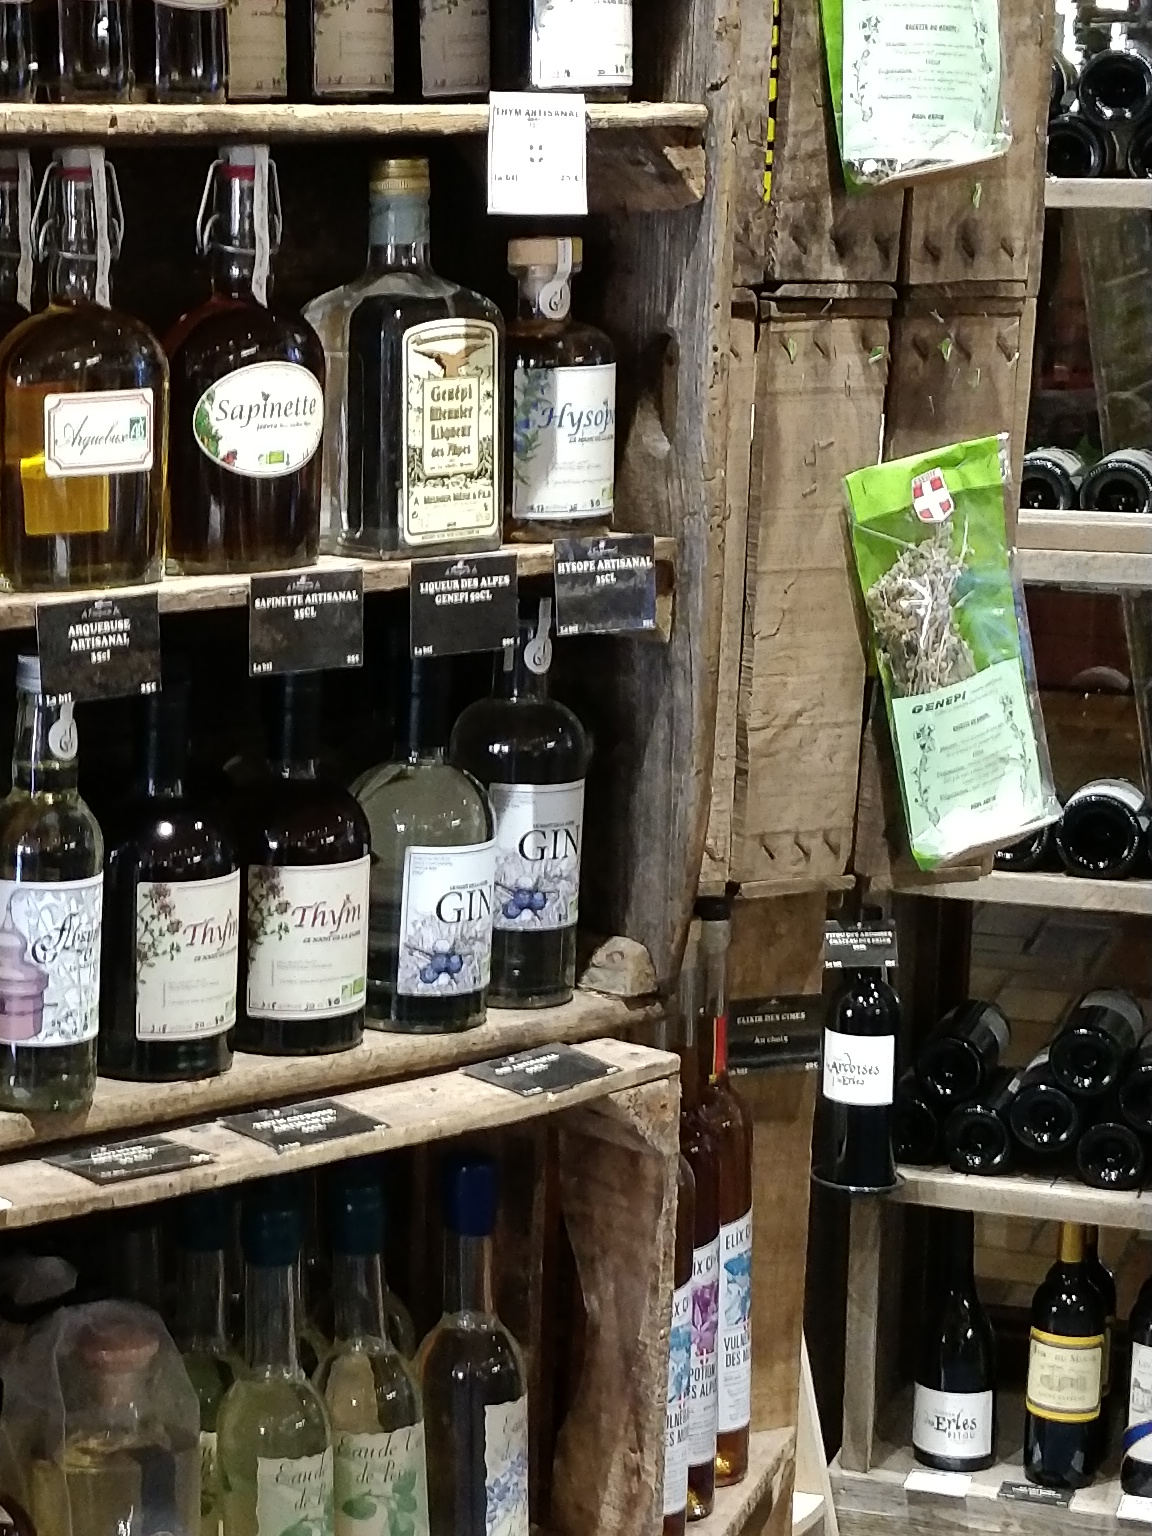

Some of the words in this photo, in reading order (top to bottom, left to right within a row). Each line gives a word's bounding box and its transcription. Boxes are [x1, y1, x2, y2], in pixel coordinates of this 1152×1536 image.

[430, 384, 474, 403] Génépi
[215, 390, 317, 431] Sapinette
[53, 412, 131, 455] Arquebus
[430, 424, 472, 441] Liqueur
[557, 560, 596, 575] HYSOPE
[597, 556, 653, 571] ARTISANAL
[419, 579, 460, 595] LIQUEUR
[460, 578, 479, 591] DES
[480, 574, 510, 589] ALPES
[254, 595, 304, 611] SAPINETTE
[305, 590, 359, 605] ARTISANAL
[434, 592, 468, 606] GENEPI
[68, 618, 131, 638] ARQUEBUSE
[70, 632, 130, 652] ARTISANAL
[911, 691, 967, 714] GENEPI
[517, 823, 582, 862] GIN
[291, 895, 362, 935] Thym
[435, 884, 492, 925] GIN
[182, 909, 240, 951] Thym
[736, 1013, 763, 1025] ELIXIR
[764, 1013, 781, 1024] DES
[934, 1408, 978, 1433] Erles
